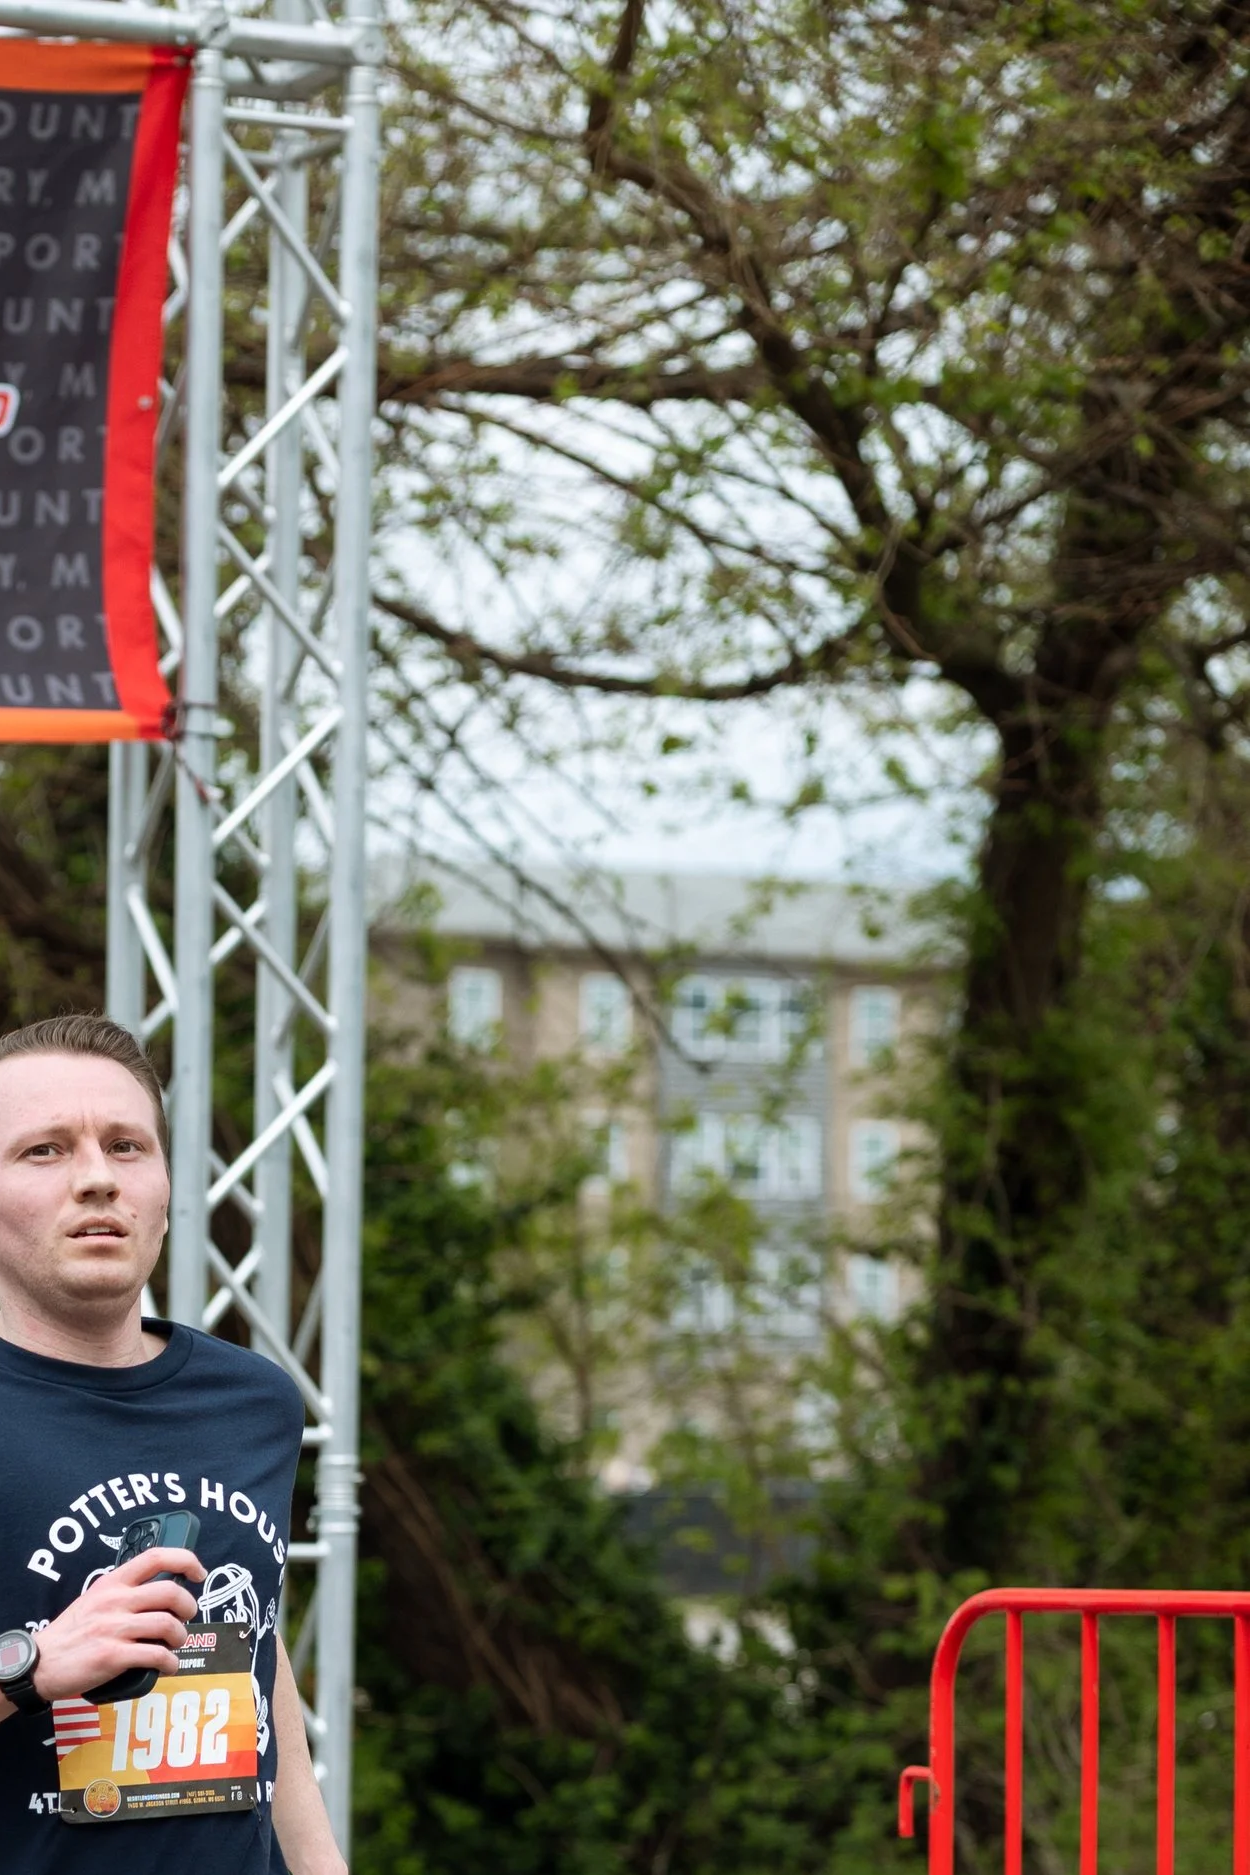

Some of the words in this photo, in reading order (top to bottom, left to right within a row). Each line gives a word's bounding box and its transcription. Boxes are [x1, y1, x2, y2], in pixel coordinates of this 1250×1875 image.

[27, 1472, 186, 1583] POTTER'S
[181, 1633, 217, 1649] AND
[111, 1688, 231, 1772] 1982
